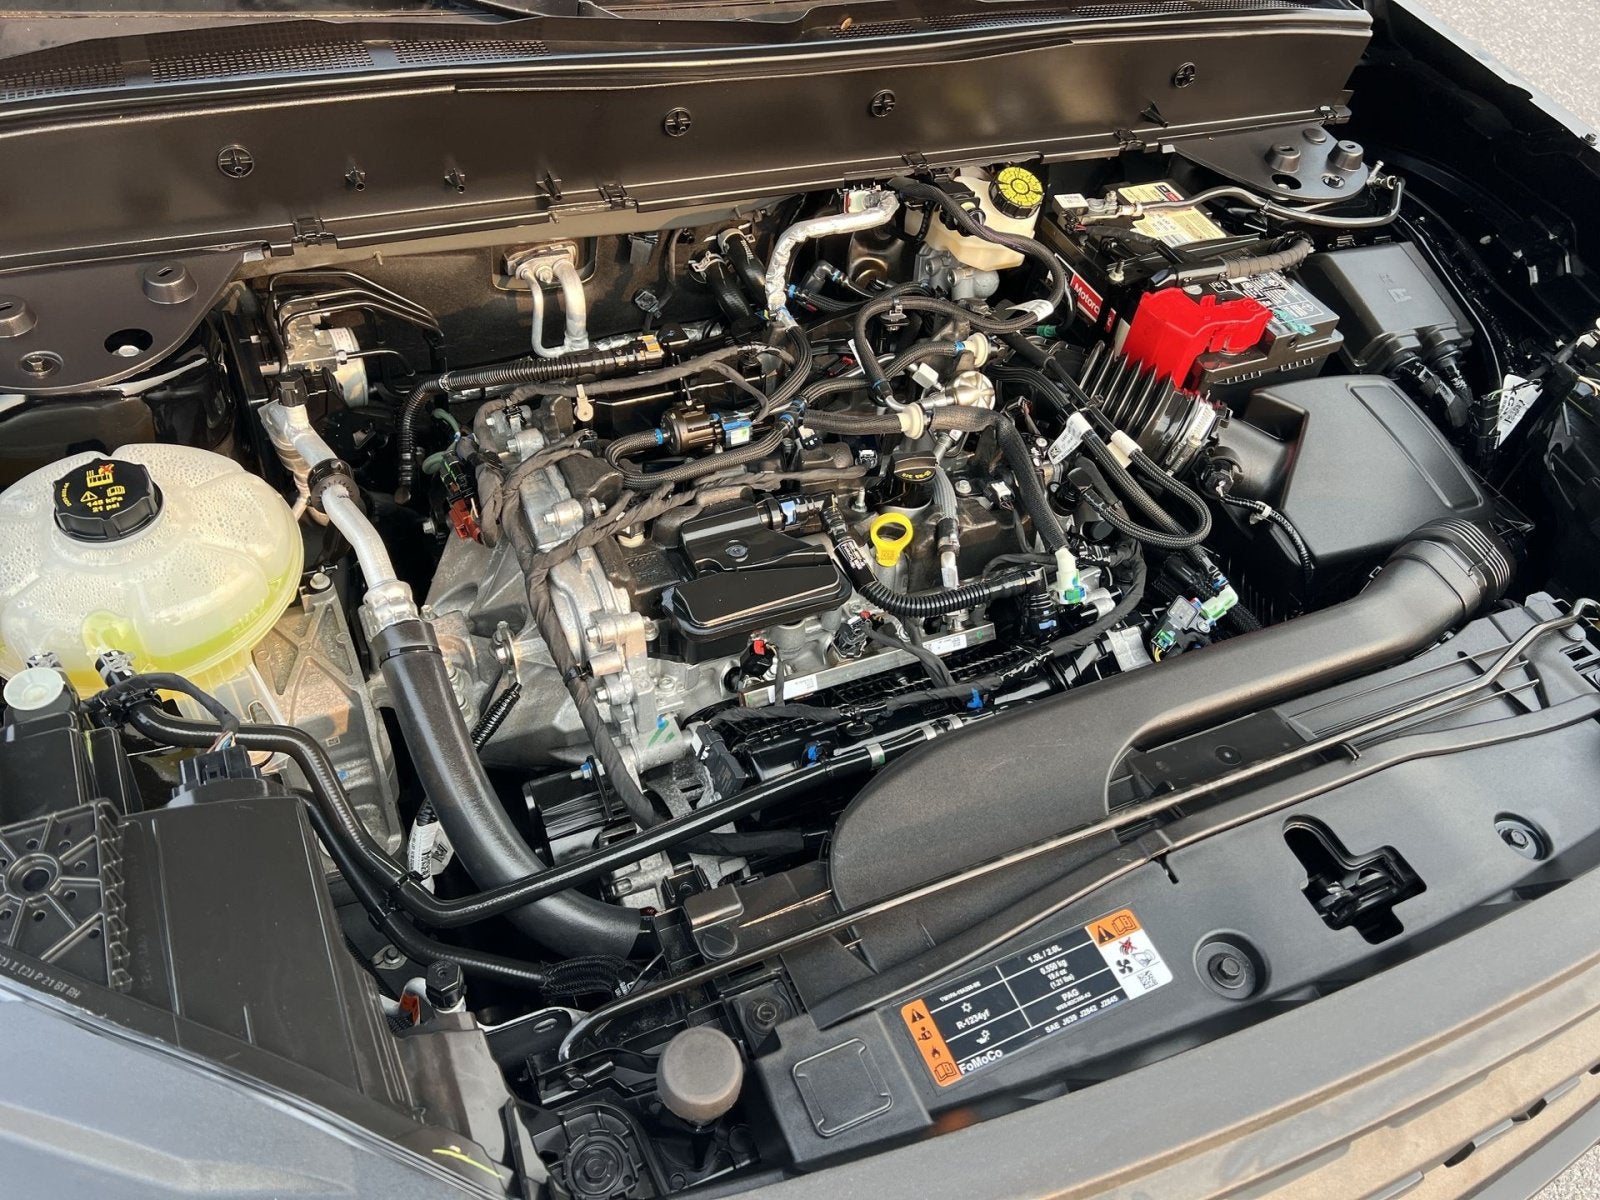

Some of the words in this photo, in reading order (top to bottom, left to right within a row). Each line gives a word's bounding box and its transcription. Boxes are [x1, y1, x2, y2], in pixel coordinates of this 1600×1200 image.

[86, 500, 104, 508] 145
[105, 496, 124, 504] kPa
[106, 503, 120, 511] psi
[1027, 952, 1044, 963] 1.5L
[1046, 944, 1062, 956] 2.0L
[1058, 959, 1068, 969] kg
[1061, 988, 1079, 1002] PAG
[955, 1008, 991, 1030] R-1234yf
[1045, 1022, 1061, 1034] SAE
[1062, 1014, 1078, 1025] J639
[1079, 1005, 1098, 1018] J2842
[958, 1048, 1003, 1075] FoMoCo
